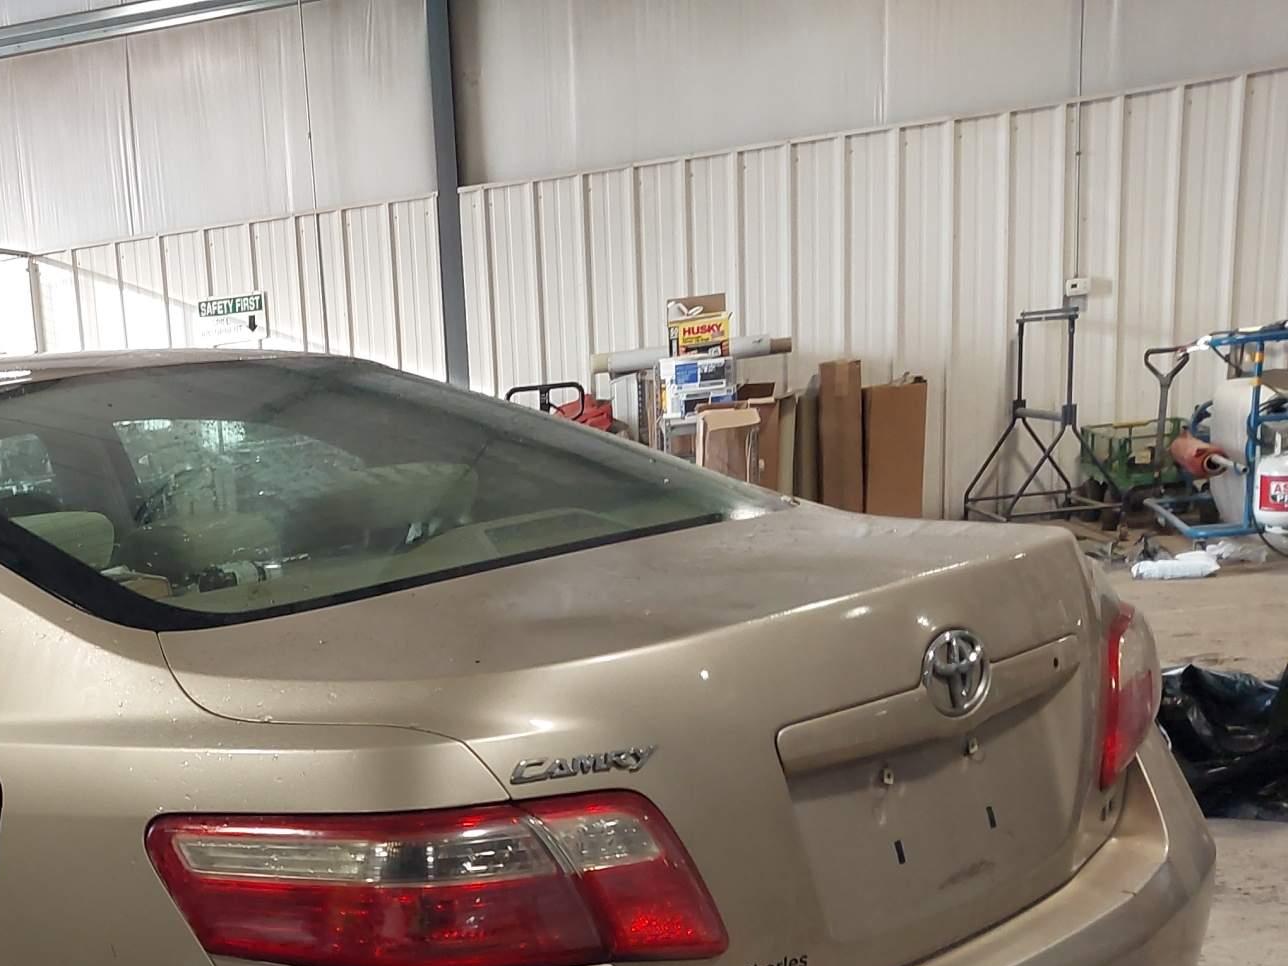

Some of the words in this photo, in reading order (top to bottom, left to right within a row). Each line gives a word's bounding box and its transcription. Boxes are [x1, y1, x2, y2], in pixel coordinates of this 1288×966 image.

[200, 299, 233, 316] SAFETY
[235, 296, 260, 312] FIRST
[683, 323, 722, 336] HUSKY
